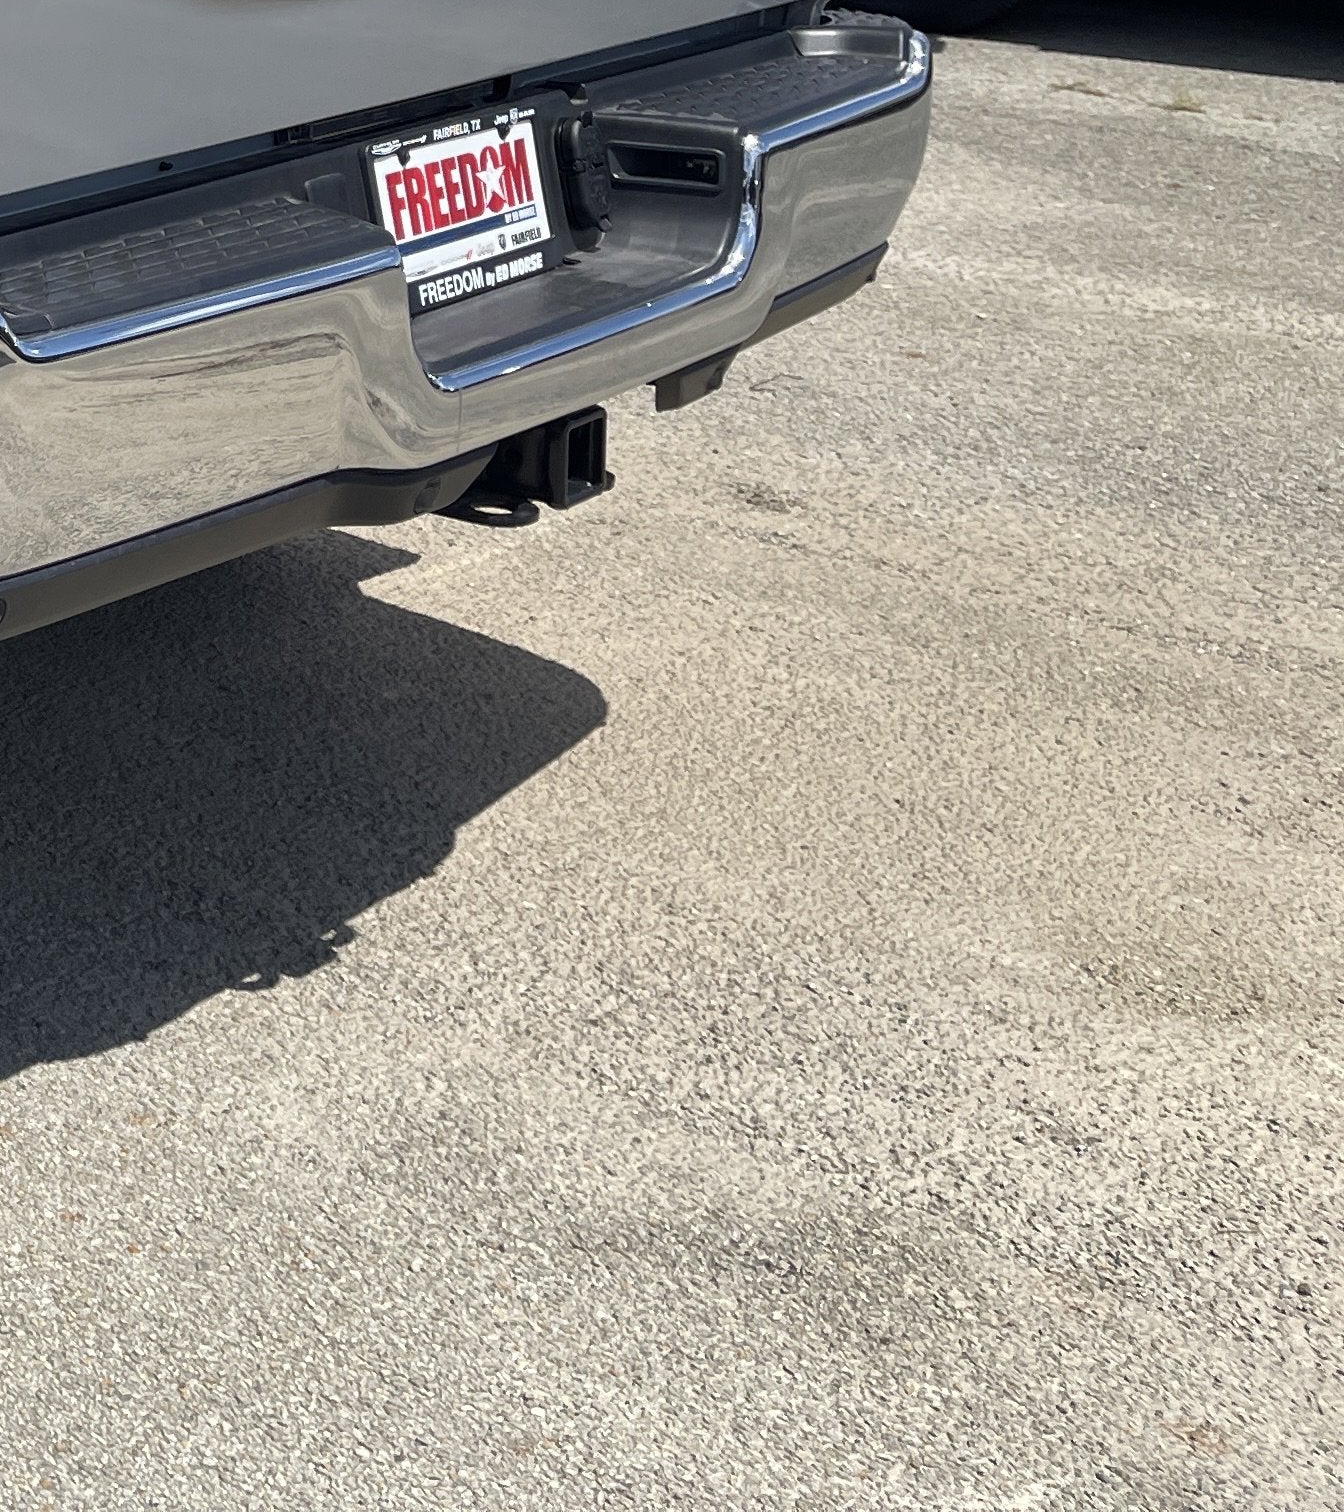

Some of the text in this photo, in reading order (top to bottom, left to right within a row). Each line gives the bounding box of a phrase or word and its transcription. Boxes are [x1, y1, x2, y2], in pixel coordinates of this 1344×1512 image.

[471, 119, 481, 131] TX
[385, 138, 534, 242] FREEDOM
[418, 267, 485, 306] FREEDOM
[495, 263, 510, 283] ED
[509, 252, 544, 277] MORSE
